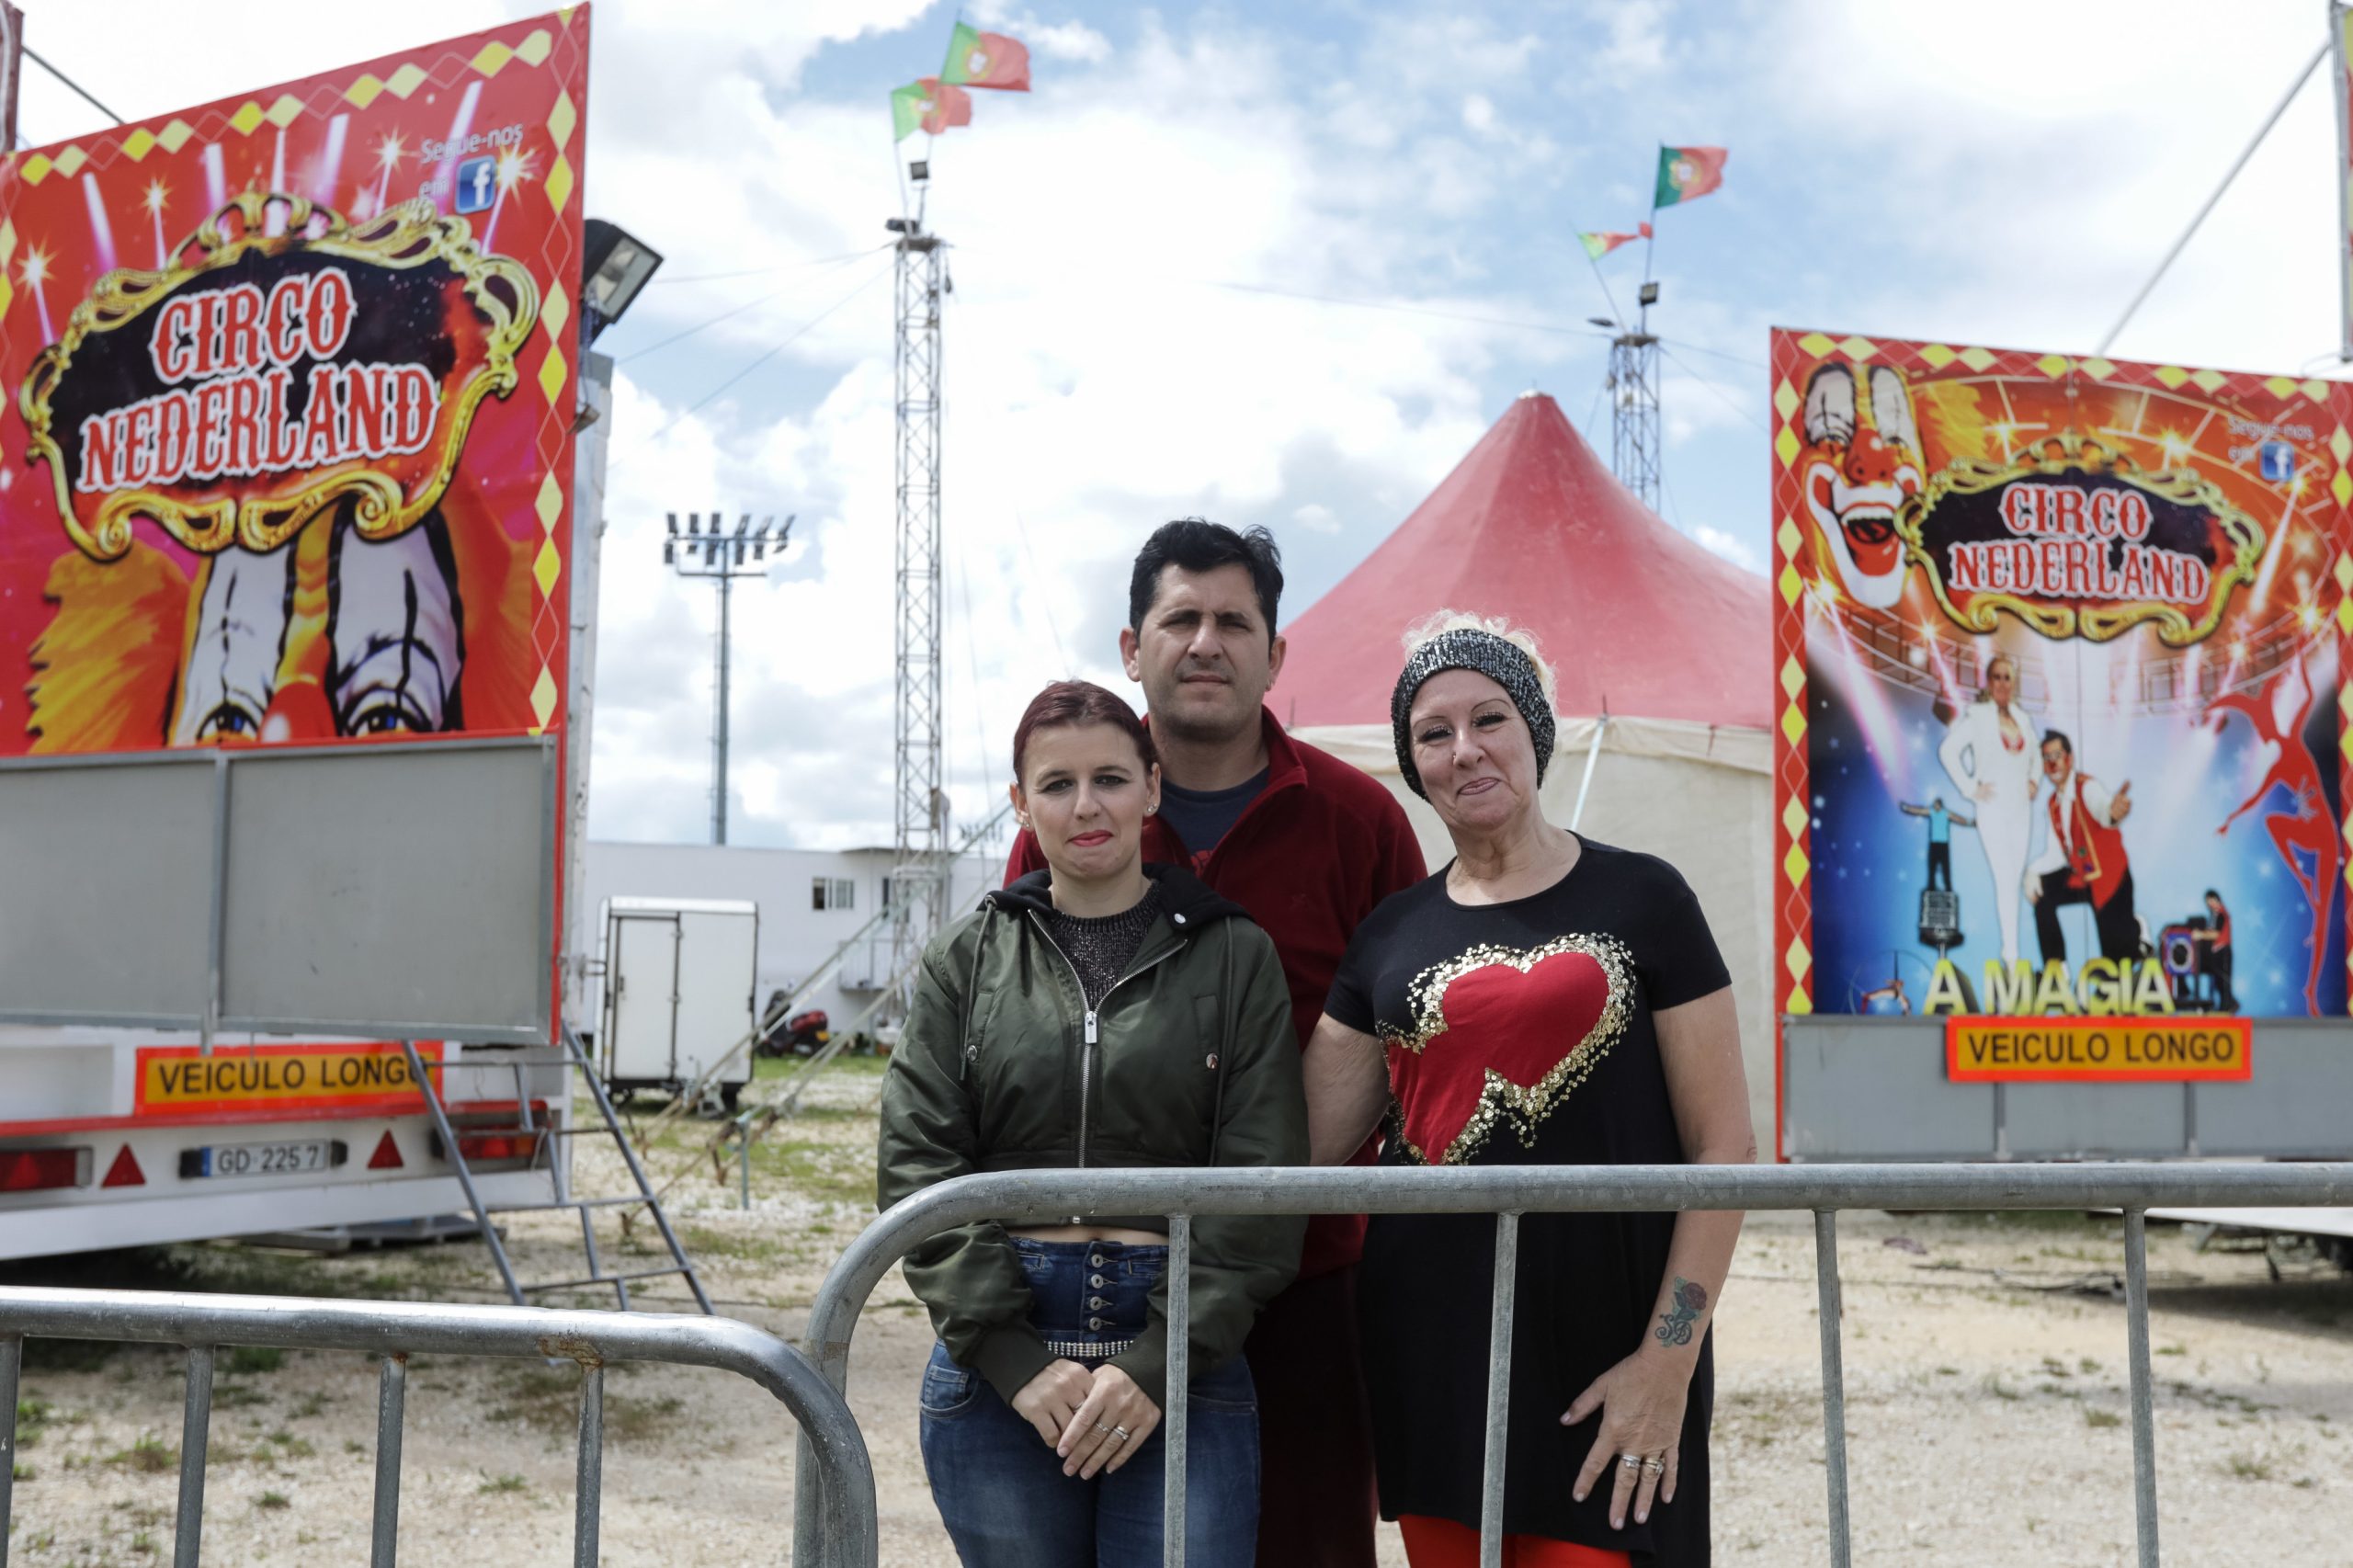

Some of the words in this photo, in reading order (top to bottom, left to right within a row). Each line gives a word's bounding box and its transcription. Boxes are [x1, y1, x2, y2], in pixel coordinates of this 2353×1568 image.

[419, 123, 524, 164] Segue-nos
[418, 177, 449, 200] em
[148, 267, 358, 384] CIRCO
[75, 360, 441, 494] NEDERLAND
[1998, 482, 2153, 542] CIRCO
[1947, 536, 2210, 605] NEDERLAND
[1923, 958, 1969, 1016] A
[1983, 957, 2177, 1016] MAGIA
[158, 1058, 306, 1095] VEICULO
[1967, 1032, 2110, 1063] VEICULO
[2125, 1031, 2235, 1062] LONGO
